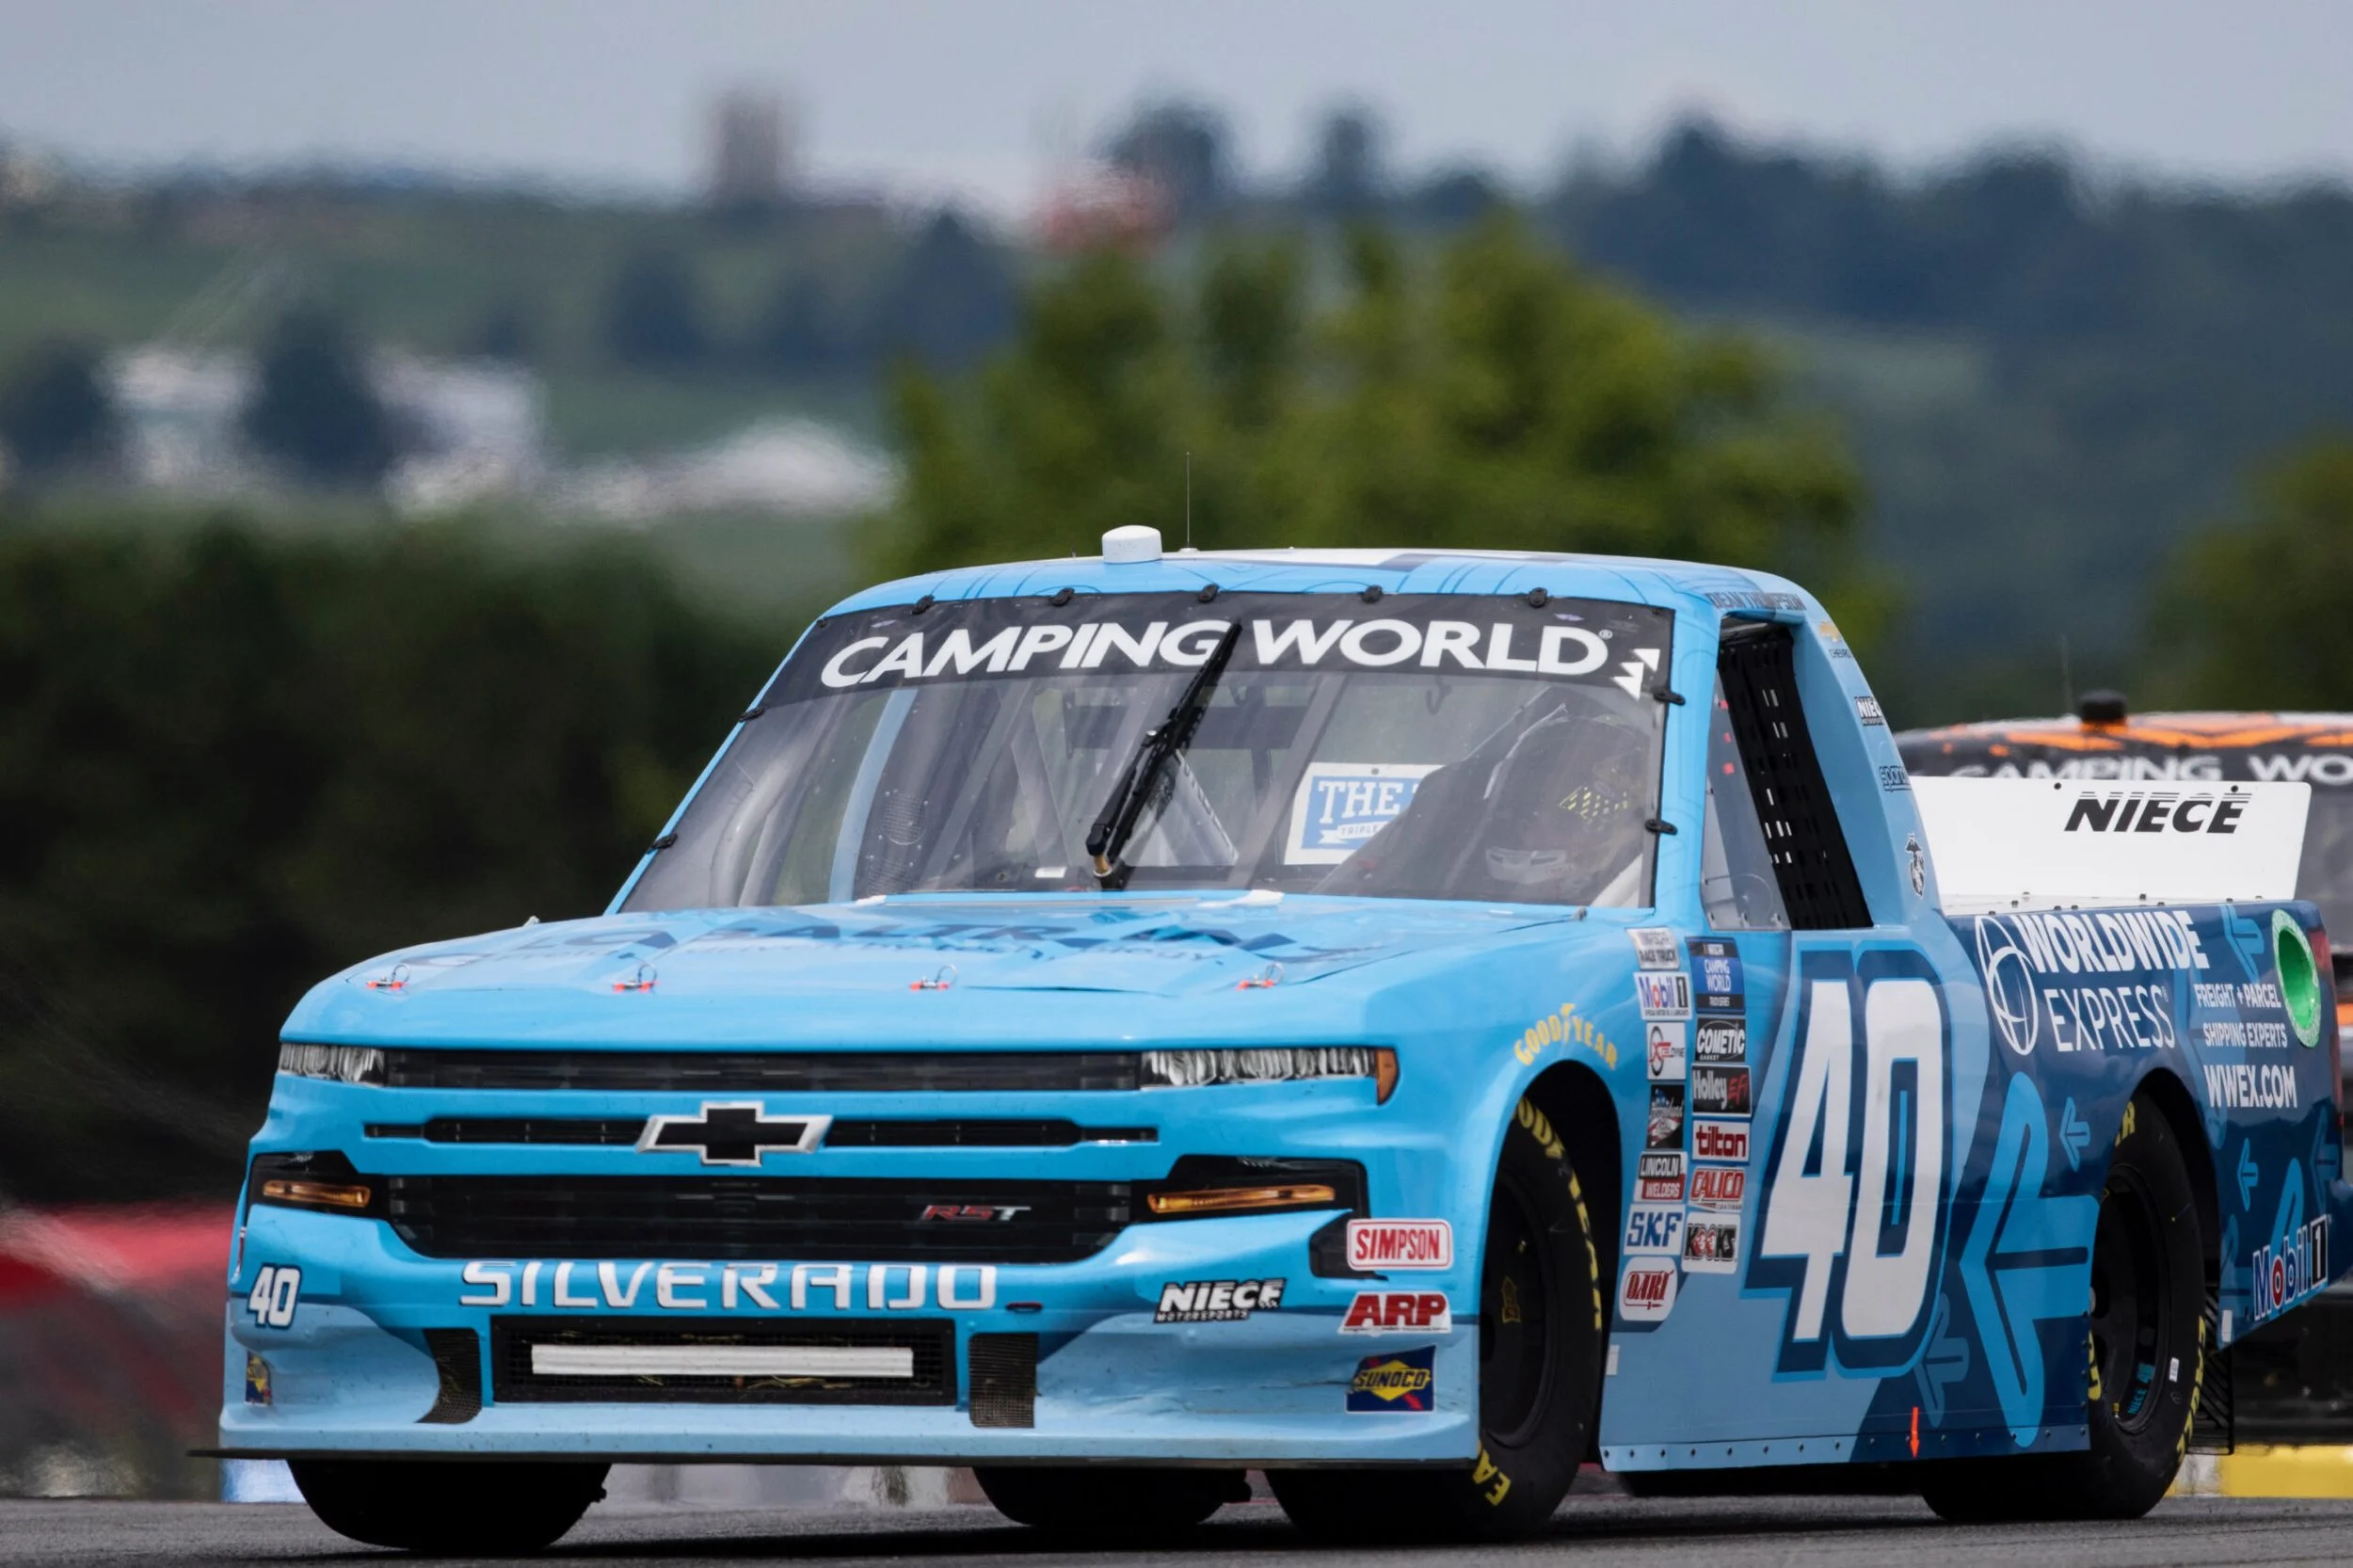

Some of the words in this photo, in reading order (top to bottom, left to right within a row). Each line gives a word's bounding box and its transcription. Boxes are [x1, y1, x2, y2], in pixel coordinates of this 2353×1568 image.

[822, 617, 1233, 687] CAMPING
[1251, 618, 1607, 676] WORLD
[1319, 780, 1403, 824] THE
[2064, 792, 2252, 833] NIECE
[2010, 910, 2209, 973] WORLDWIDE
[1639, 976, 1675, 1009] Mobil
[1706, 974, 1731, 992] WORLD
[2194, 984, 2234, 1008] FREIGHT
[2242, 984, 2281, 1008] PARCEL
[2042, 984, 2175, 1052] EXPRESS
[1514, 1002, 1617, 1070] GOODYEAR
[1696, 1028, 1745, 1054] COMETIC
[2203, 1022, 2247, 1047] SHIPPING
[2247, 1022, 2287, 1048] EXPERTS
[1692, 1070, 1727, 1111] Holley
[2203, 1064, 2297, 1109] WWEX.COM
[1696, 1125, 1747, 1158] tilton
[1640, 1157, 1680, 1176] LINCOLN
[1760, 979, 1943, 1342] 40
[1646, 1181, 1680, 1198] WELDERS
[1690, 1170, 1745, 1201] CALICO
[920, 1205, 1032, 1221] RST
[1626, 1212, 1682, 1247] SKF
[1355, 1228, 1441, 1259] SIMPSON
[458, 1260, 998, 1311] SILVERADO
[2253, 1224, 2308, 1321] Mobil
[248, 1266, 300, 1327] 40
[1159, 1279, 1285, 1312] NIECE
[1344, 1294, 1447, 1326] ARP
[1156, 1309, 1249, 1322] MOTORSPORTS
[1353, 1368, 1431, 1389] SUNOCO
